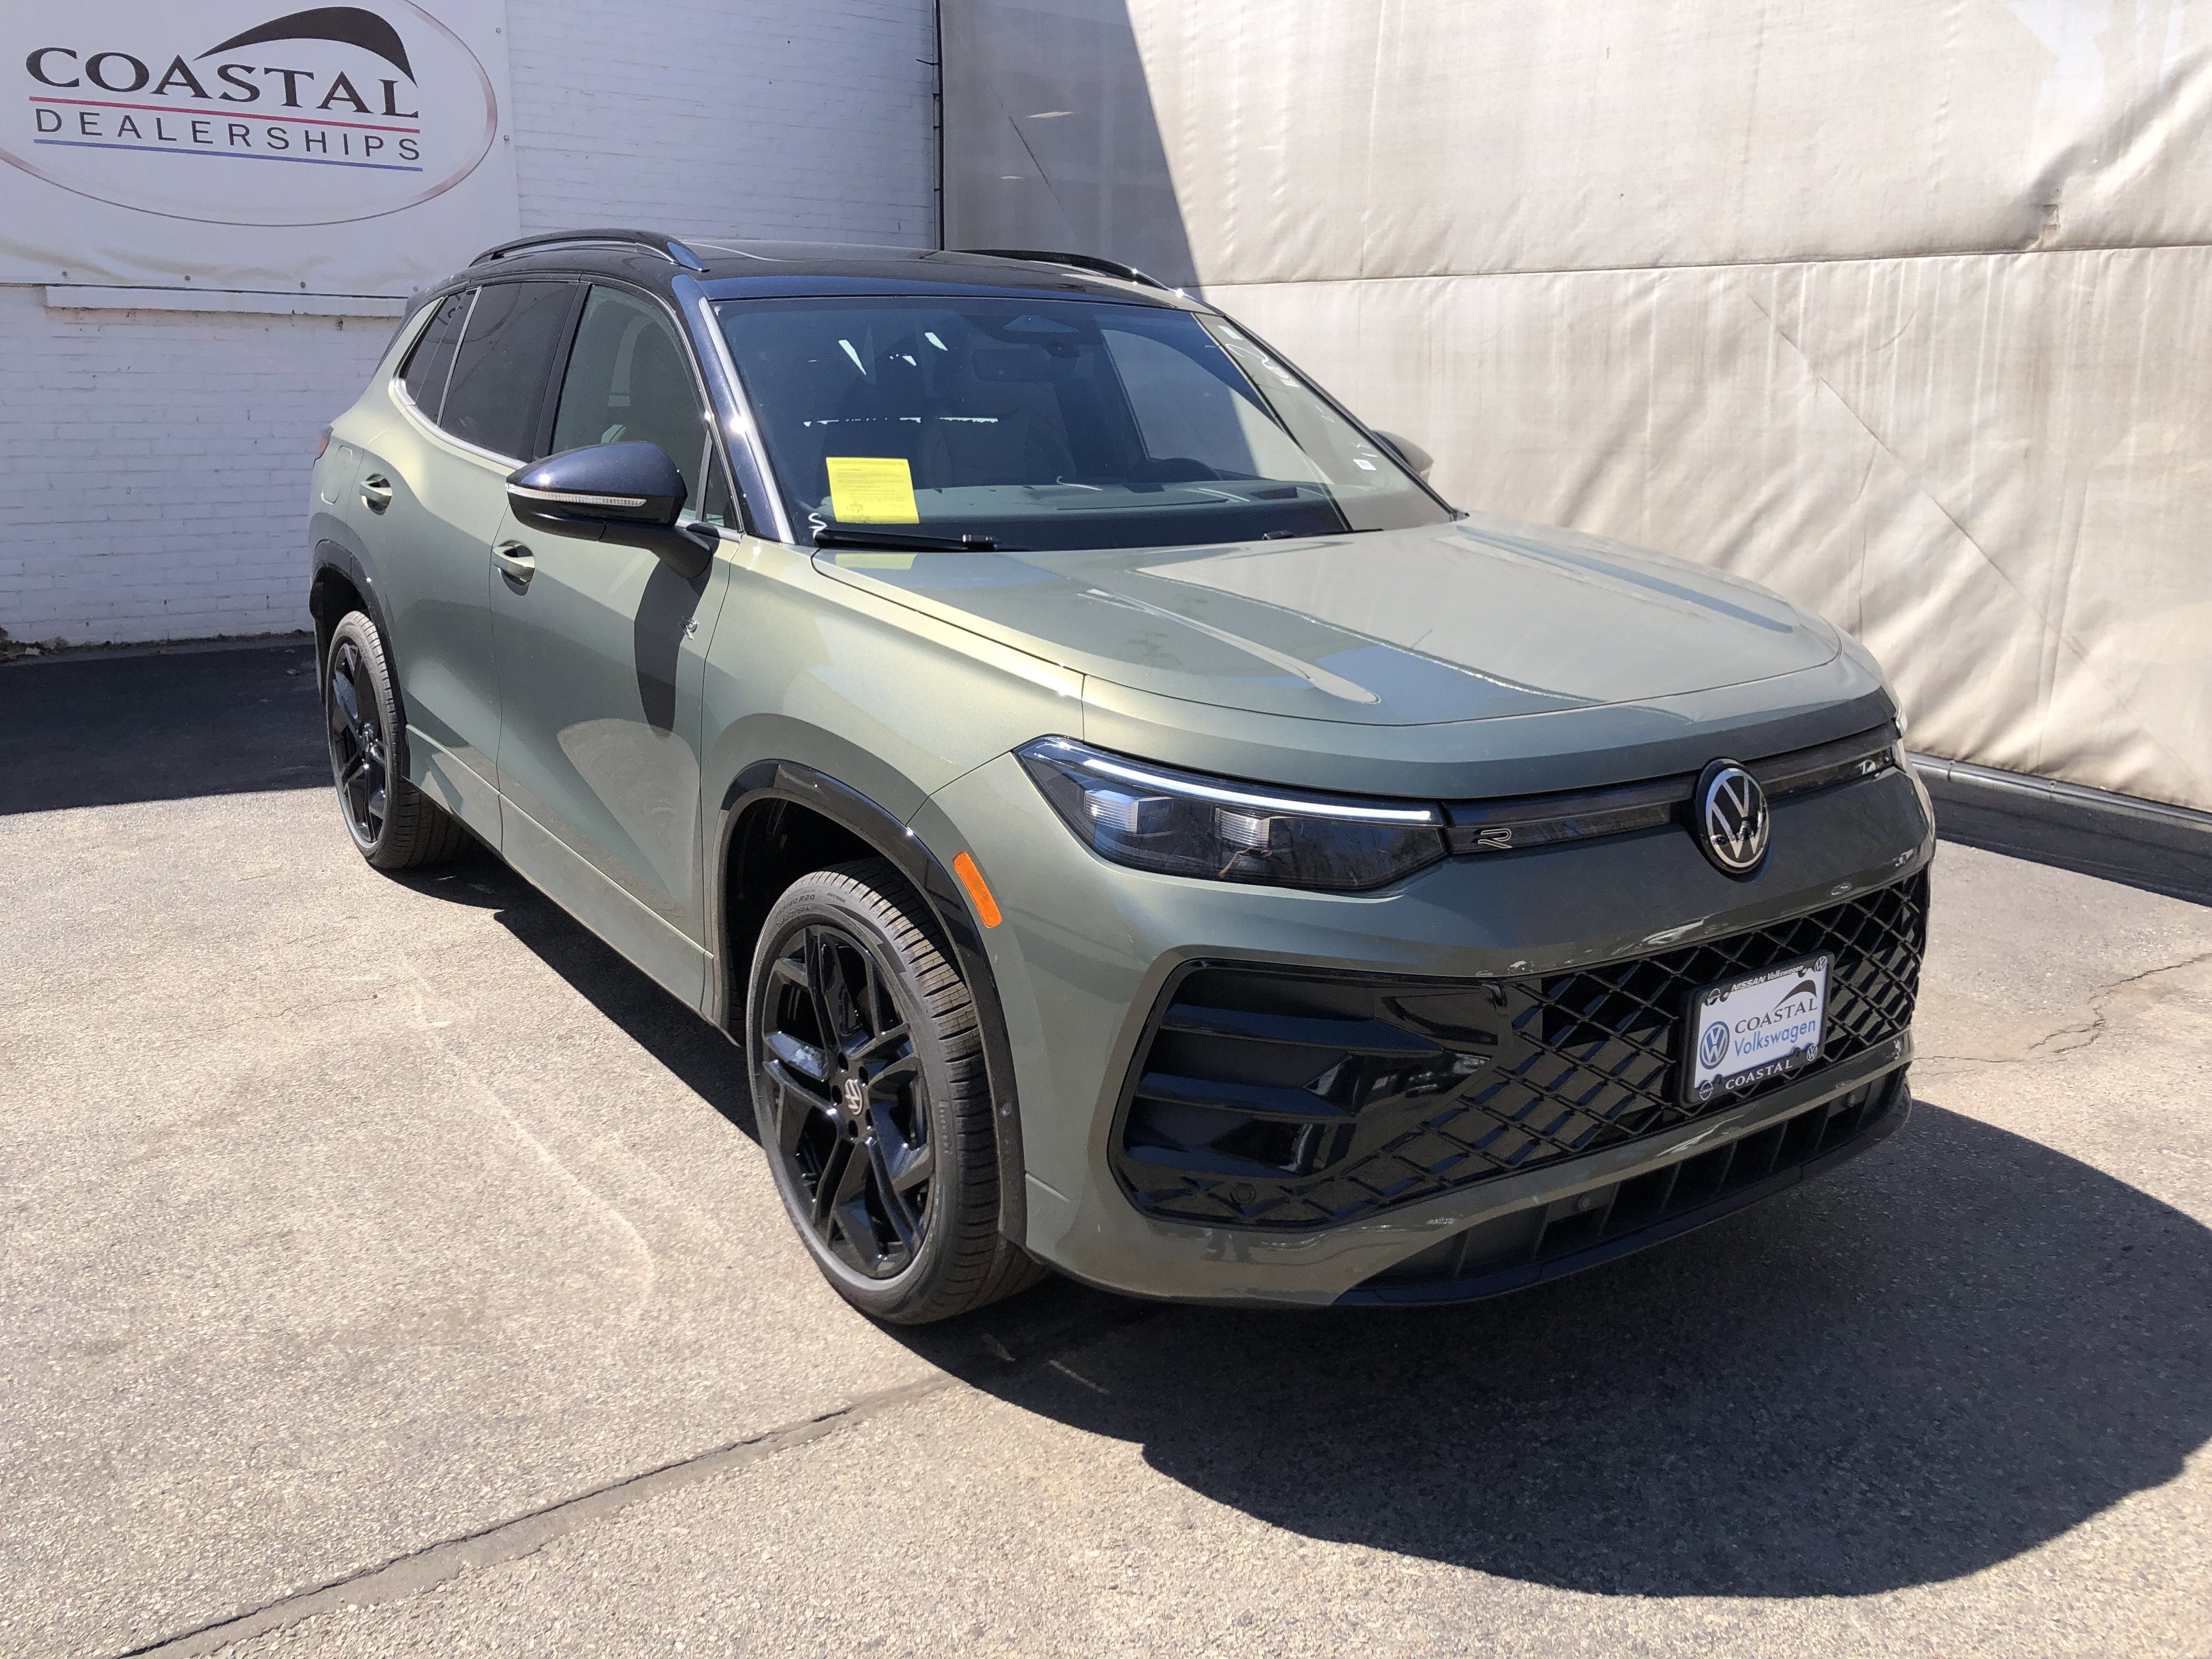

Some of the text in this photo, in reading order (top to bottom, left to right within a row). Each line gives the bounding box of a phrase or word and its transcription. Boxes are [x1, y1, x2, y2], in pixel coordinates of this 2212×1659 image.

[26, 47, 419, 119] COASTAL
[35, 109, 420, 161] DEALERSHIPS
[799, 894, 815, 902] R20
[827, 892, 847, 904] OUTSIDE
[1731, 975, 1766, 991] NISSAN
[1735, 998, 1818, 1034] COASTAL
[1734, 1020, 1816, 1057] Volkswagen
[1725, 1059, 1792, 1090] COASTAL
